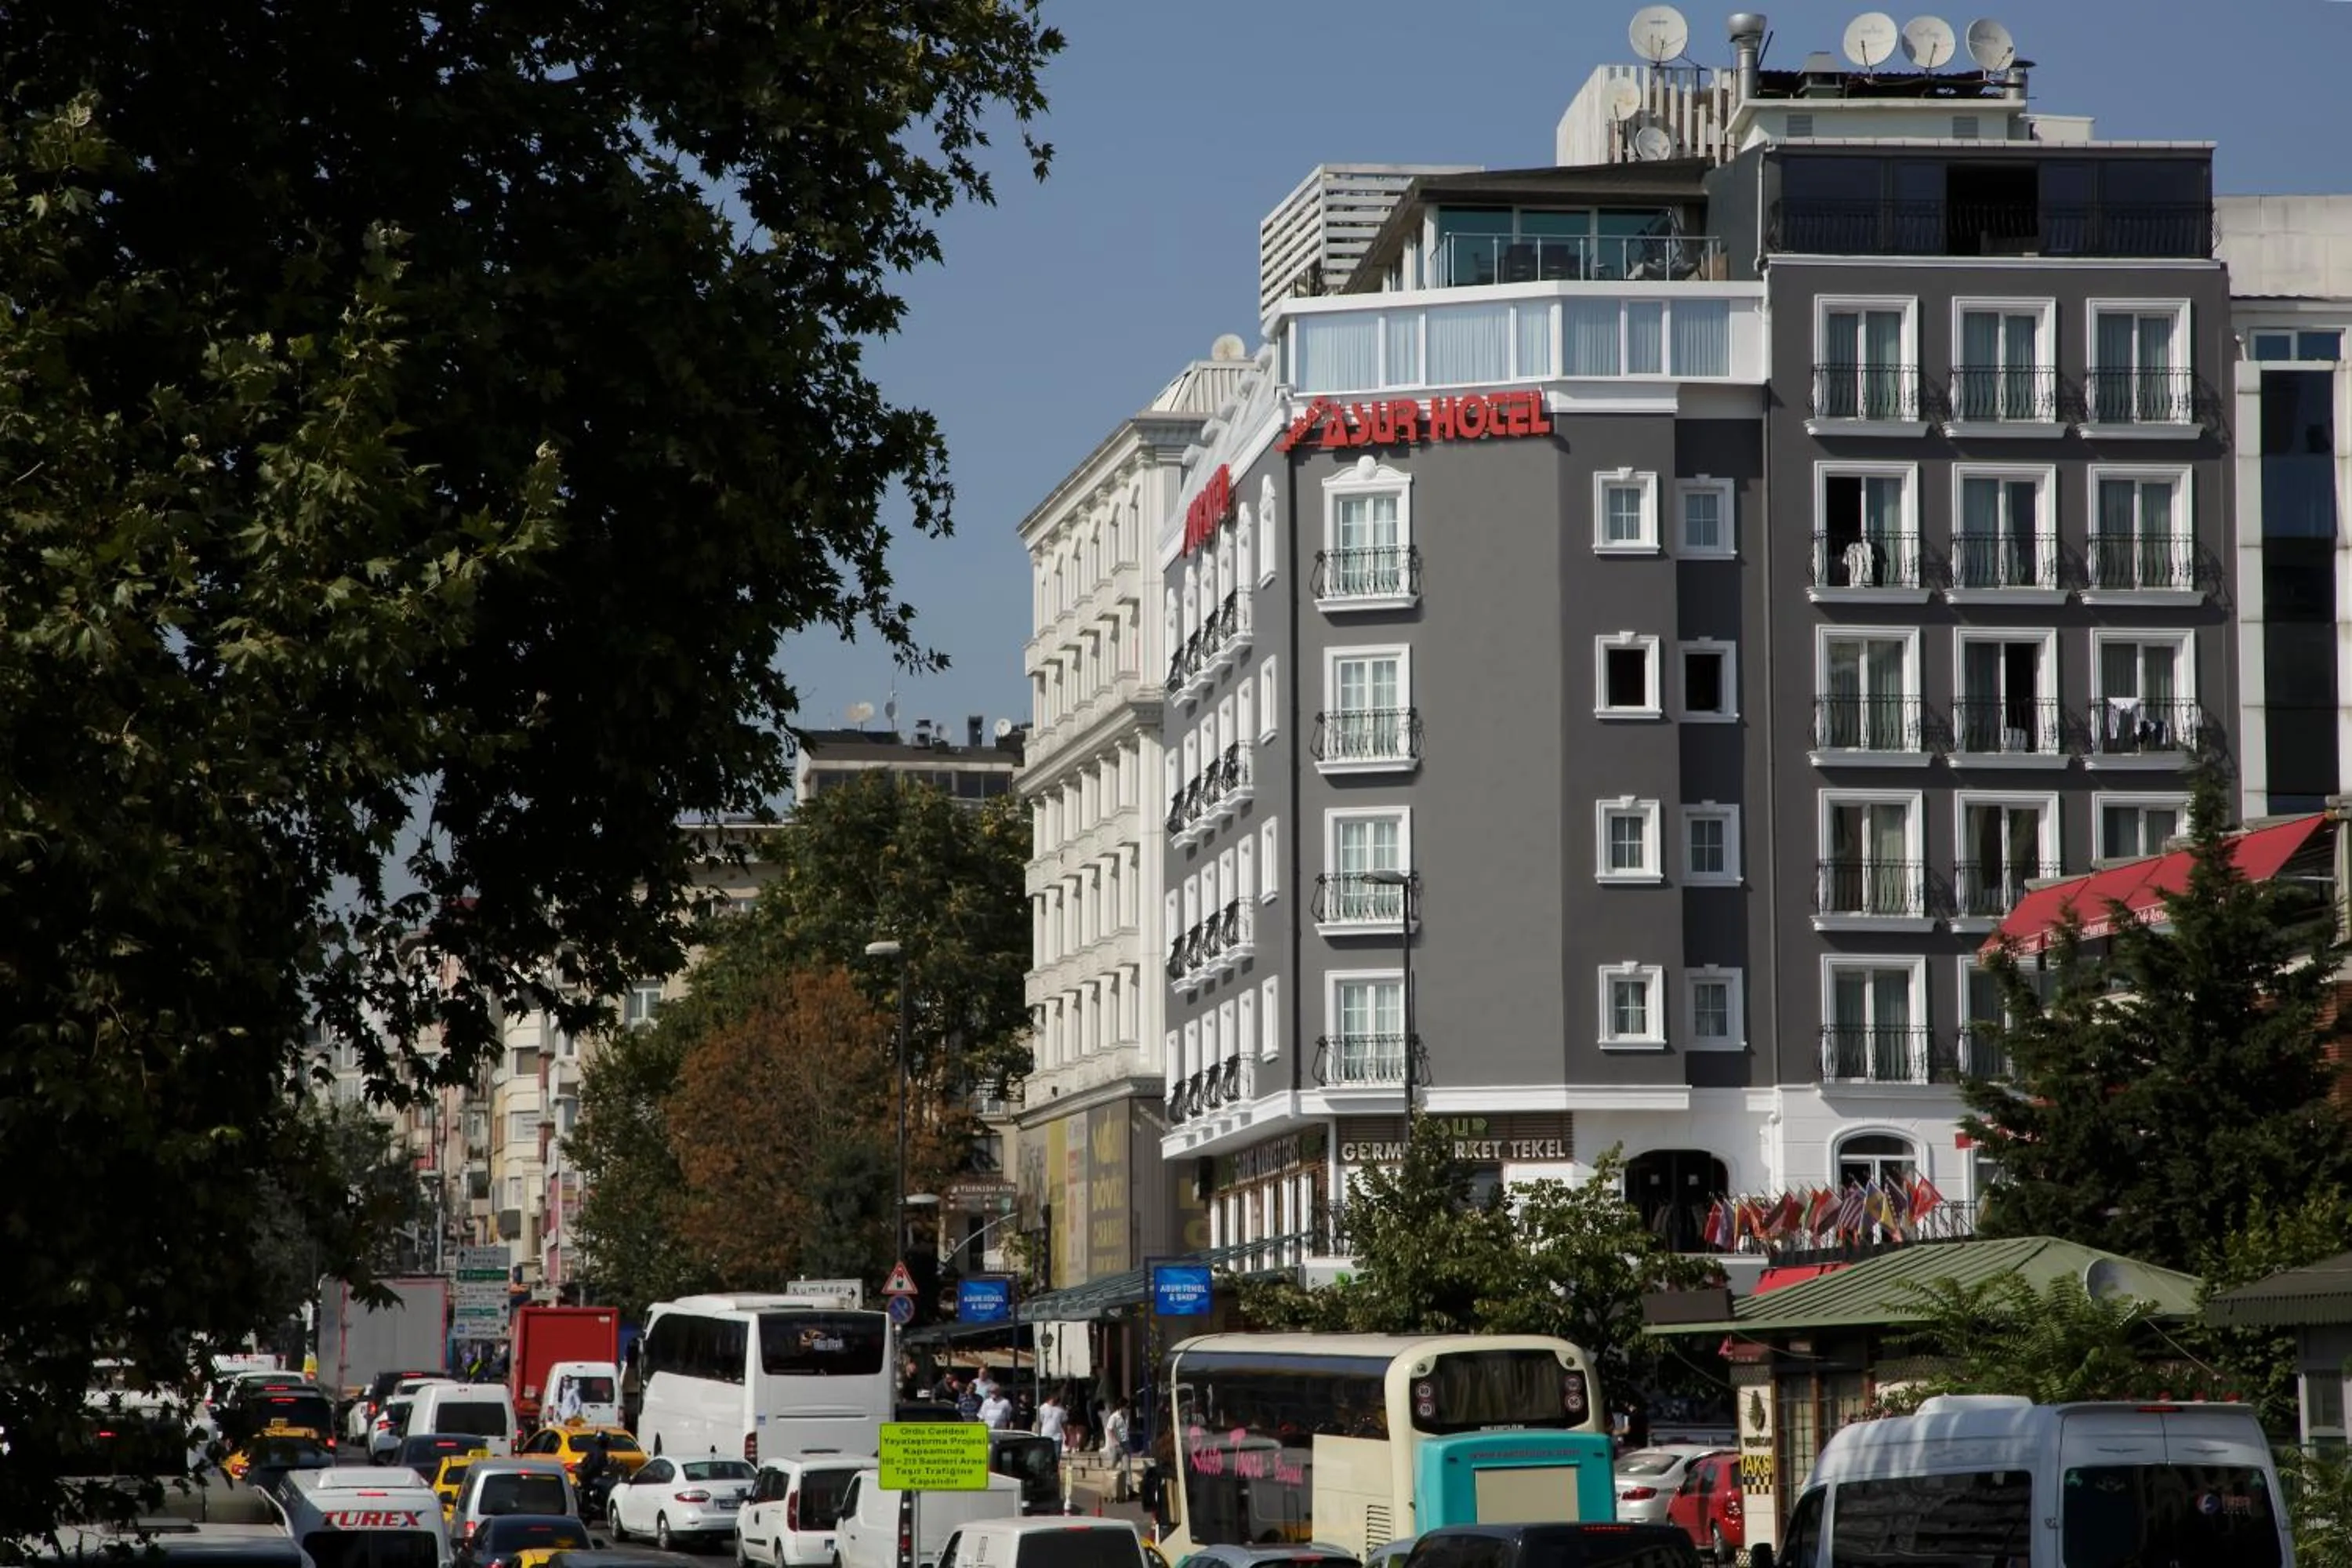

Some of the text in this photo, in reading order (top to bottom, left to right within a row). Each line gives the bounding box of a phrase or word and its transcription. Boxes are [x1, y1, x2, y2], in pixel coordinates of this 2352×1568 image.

[1429, 390, 1550, 441] HOTEL
[1454, 1141, 1502, 1159] RKET
[1510, 1139, 1566, 1158] TEKEL
[323, 1510, 426, 1527] TUREX
